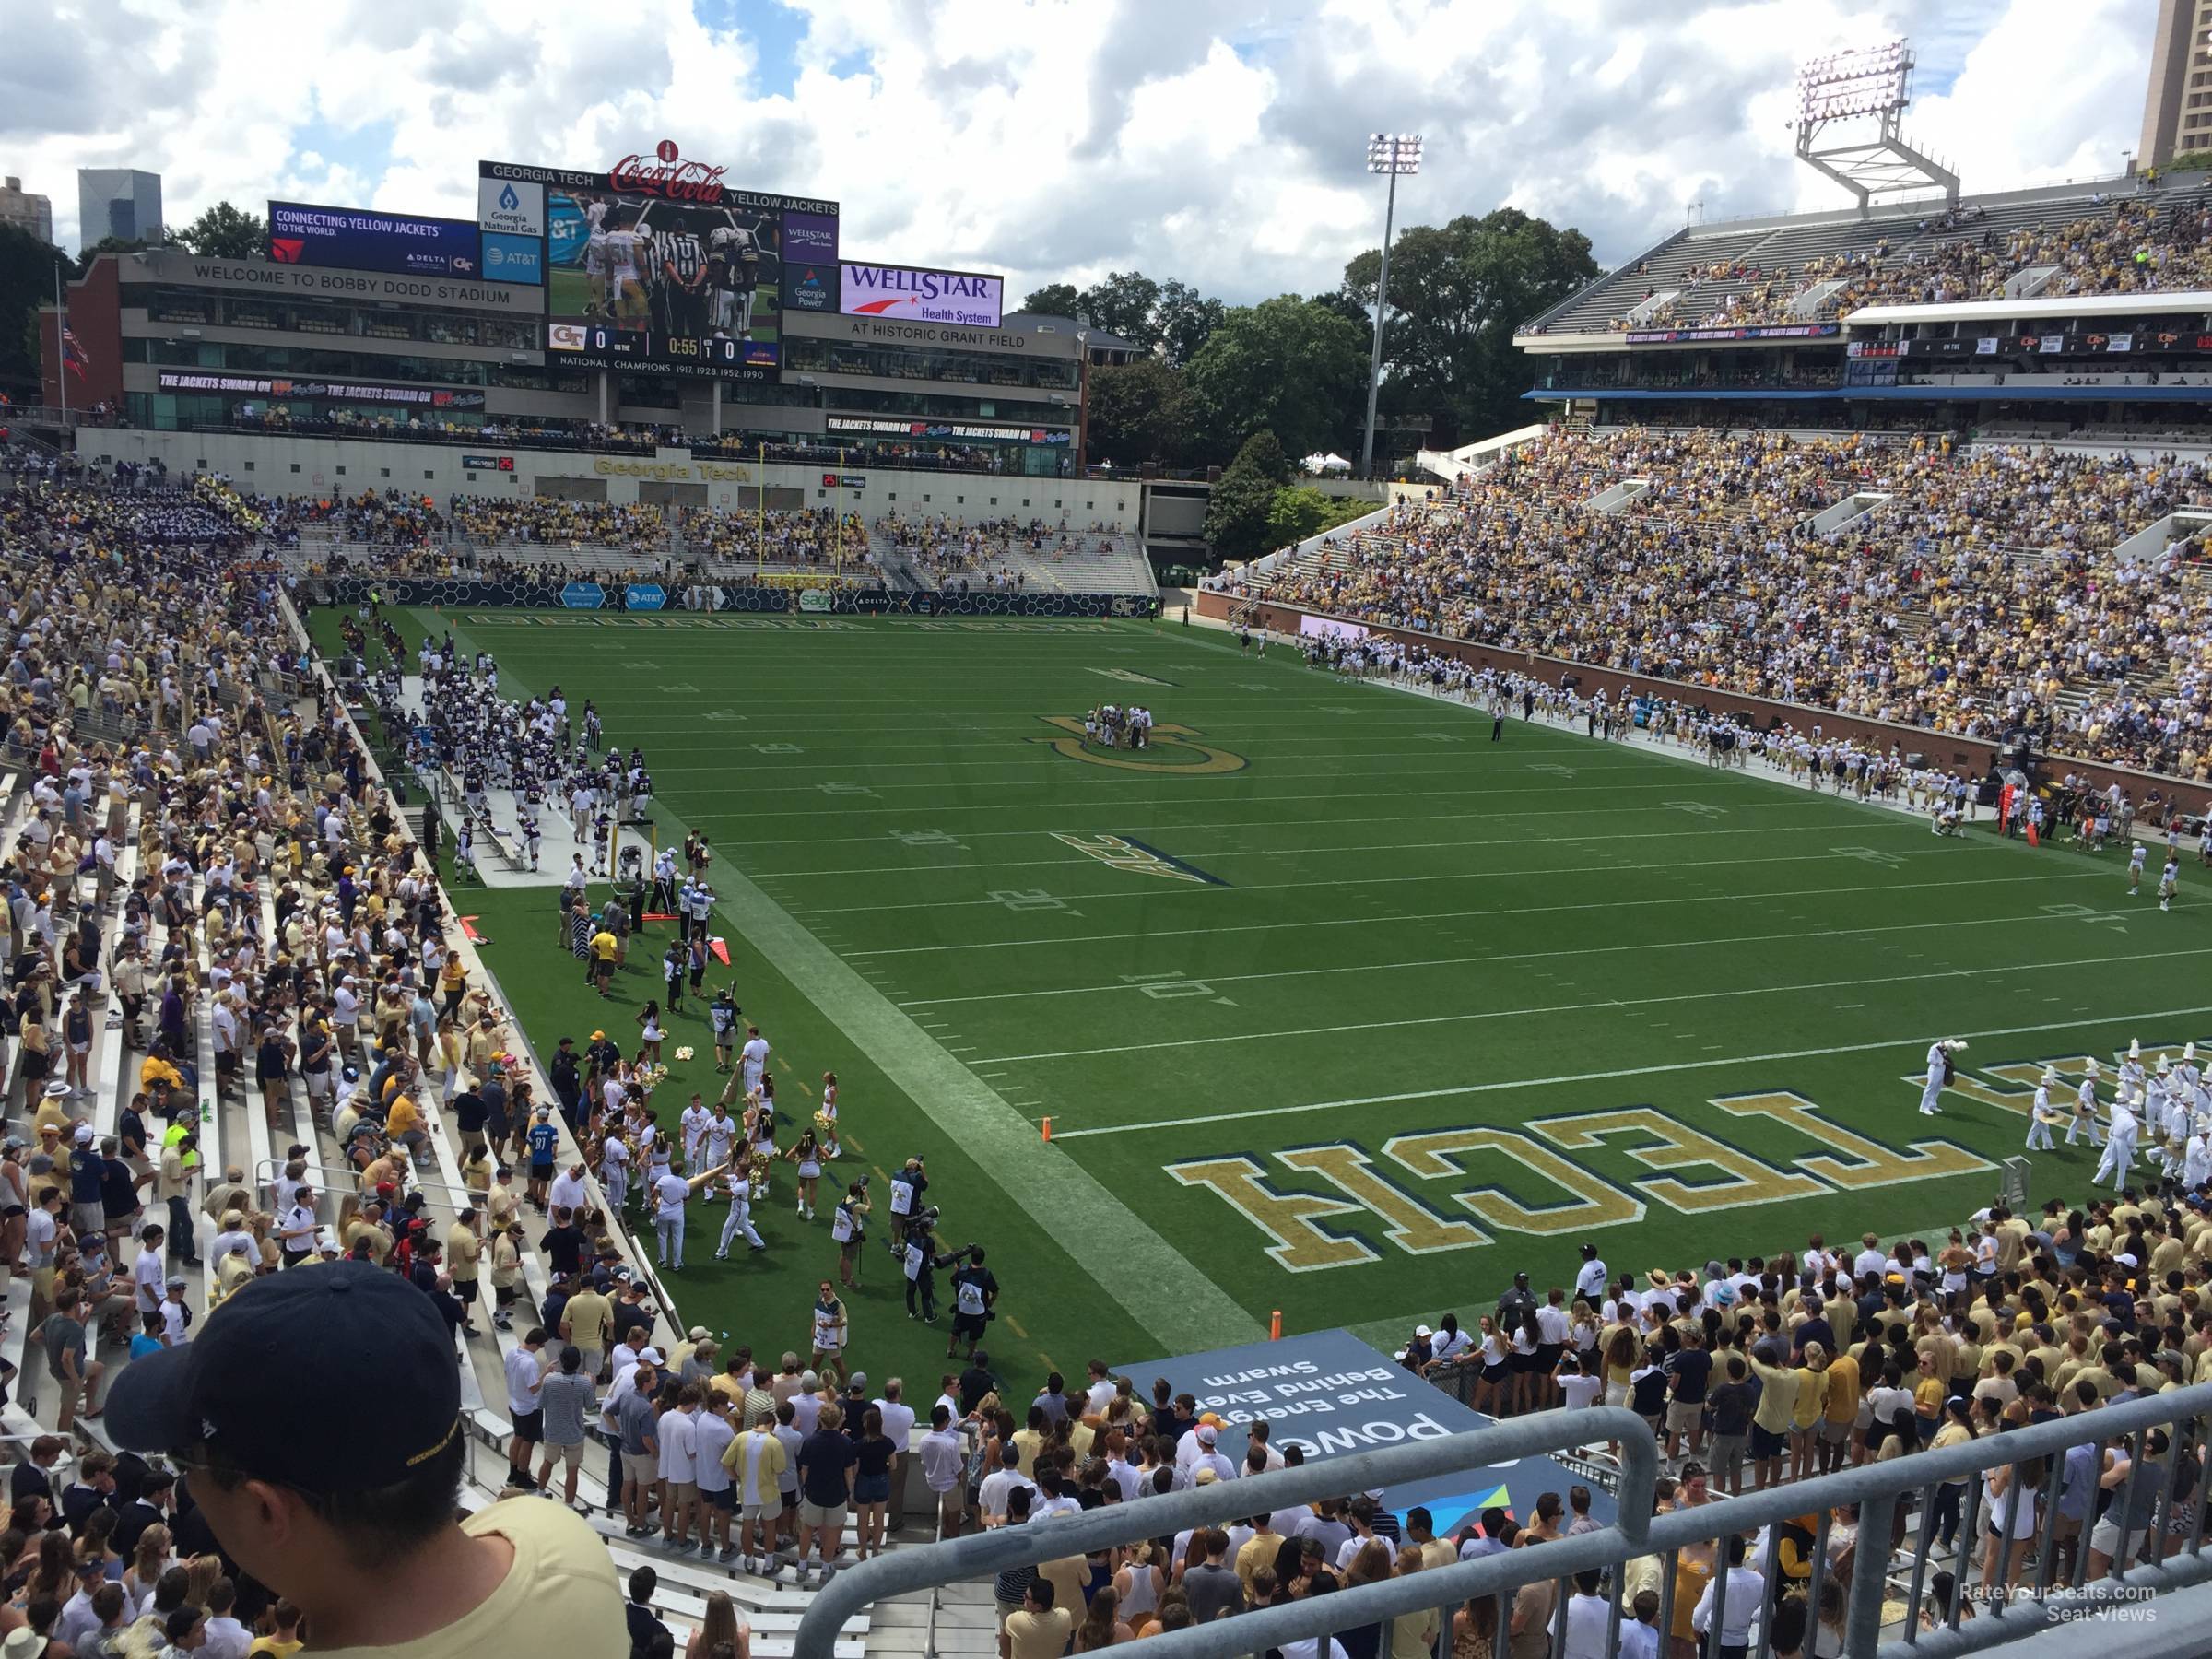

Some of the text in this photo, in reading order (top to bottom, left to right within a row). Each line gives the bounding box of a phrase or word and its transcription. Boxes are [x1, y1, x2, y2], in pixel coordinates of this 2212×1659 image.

[493, 165, 594, 186] GEORGIA TECH
[610, 155, 729, 203] Coca-Cola
[731, 192, 838, 215] YELLOW JACKETS
[276, 210, 347, 228] CONNECTING
[349, 218, 391, 232] YELLOW
[491, 211, 526, 223] Georgia
[277, 223, 337, 237] TO THE WORLD.
[484, 221, 537, 234] Natural Gas
[788, 228, 832, 240] WELLSTAR
[417, 254, 445, 264] DELTA
[507, 253, 537, 265] AT&T
[194, 265, 510, 303] WELCOME TO BOBBY DODD STADIUM
[851, 265, 987, 300] WELLSTAR
[794, 288, 826, 299] Georgia
[798, 297, 822, 307] Power
[922, 307, 991, 325] Health System
[553, 326, 583, 346] GT
[596, 331, 606, 349] 0
[852, 324, 1024, 347] AT HISTORIC GRANT FIELD
[669, 337, 697, 355] 0:55
[725, 341, 735, 359] 0
[560, 356, 608, 368] NATIONAL
[614, 360, 670, 372] CHAMPIONS
[744, 371, 763, 379] 1990
[160, 374, 178, 386] THE
[179, 375, 218, 389] JACKETS
[220, 378, 256, 391] SWARM
[257, 381, 271, 392] ON
[327, 385, 344, 396] THE
[345, 386, 382, 399] JACKETS
[383, 388, 417, 402] SWARM
[418, 391, 431, 402] ON
[828, 418, 841, 428] THE
[841, 419, 872, 430] JACKETS
[873, 420, 900, 432] SWARM
[900, 423, 911, 433] ON
[952, 426, 963, 436] THE
[963, 427, 994, 438] JACKETS
[994, 429, 1020, 440] SWARM
[1020, 430, 1030, 440] ON
[594, 457, 752, 482] Georgia Tech
[640, 594, 662, 603] AT&T
[1112, 598, 1135, 617] GT
[986, 888, 1068, 912] 20
[2039, 903, 2129, 924] 10
[1118, 971, 1216, 999] 10
[1162, 1088, 2000, 1273] TECH
[1202, 1360, 1319, 1387] Swarm
[1194, 1367, 1395, 1411] Behind Ever
[1337, 1386, 1406, 1406] The
[1276, 1413, 1453, 1458] Powe
